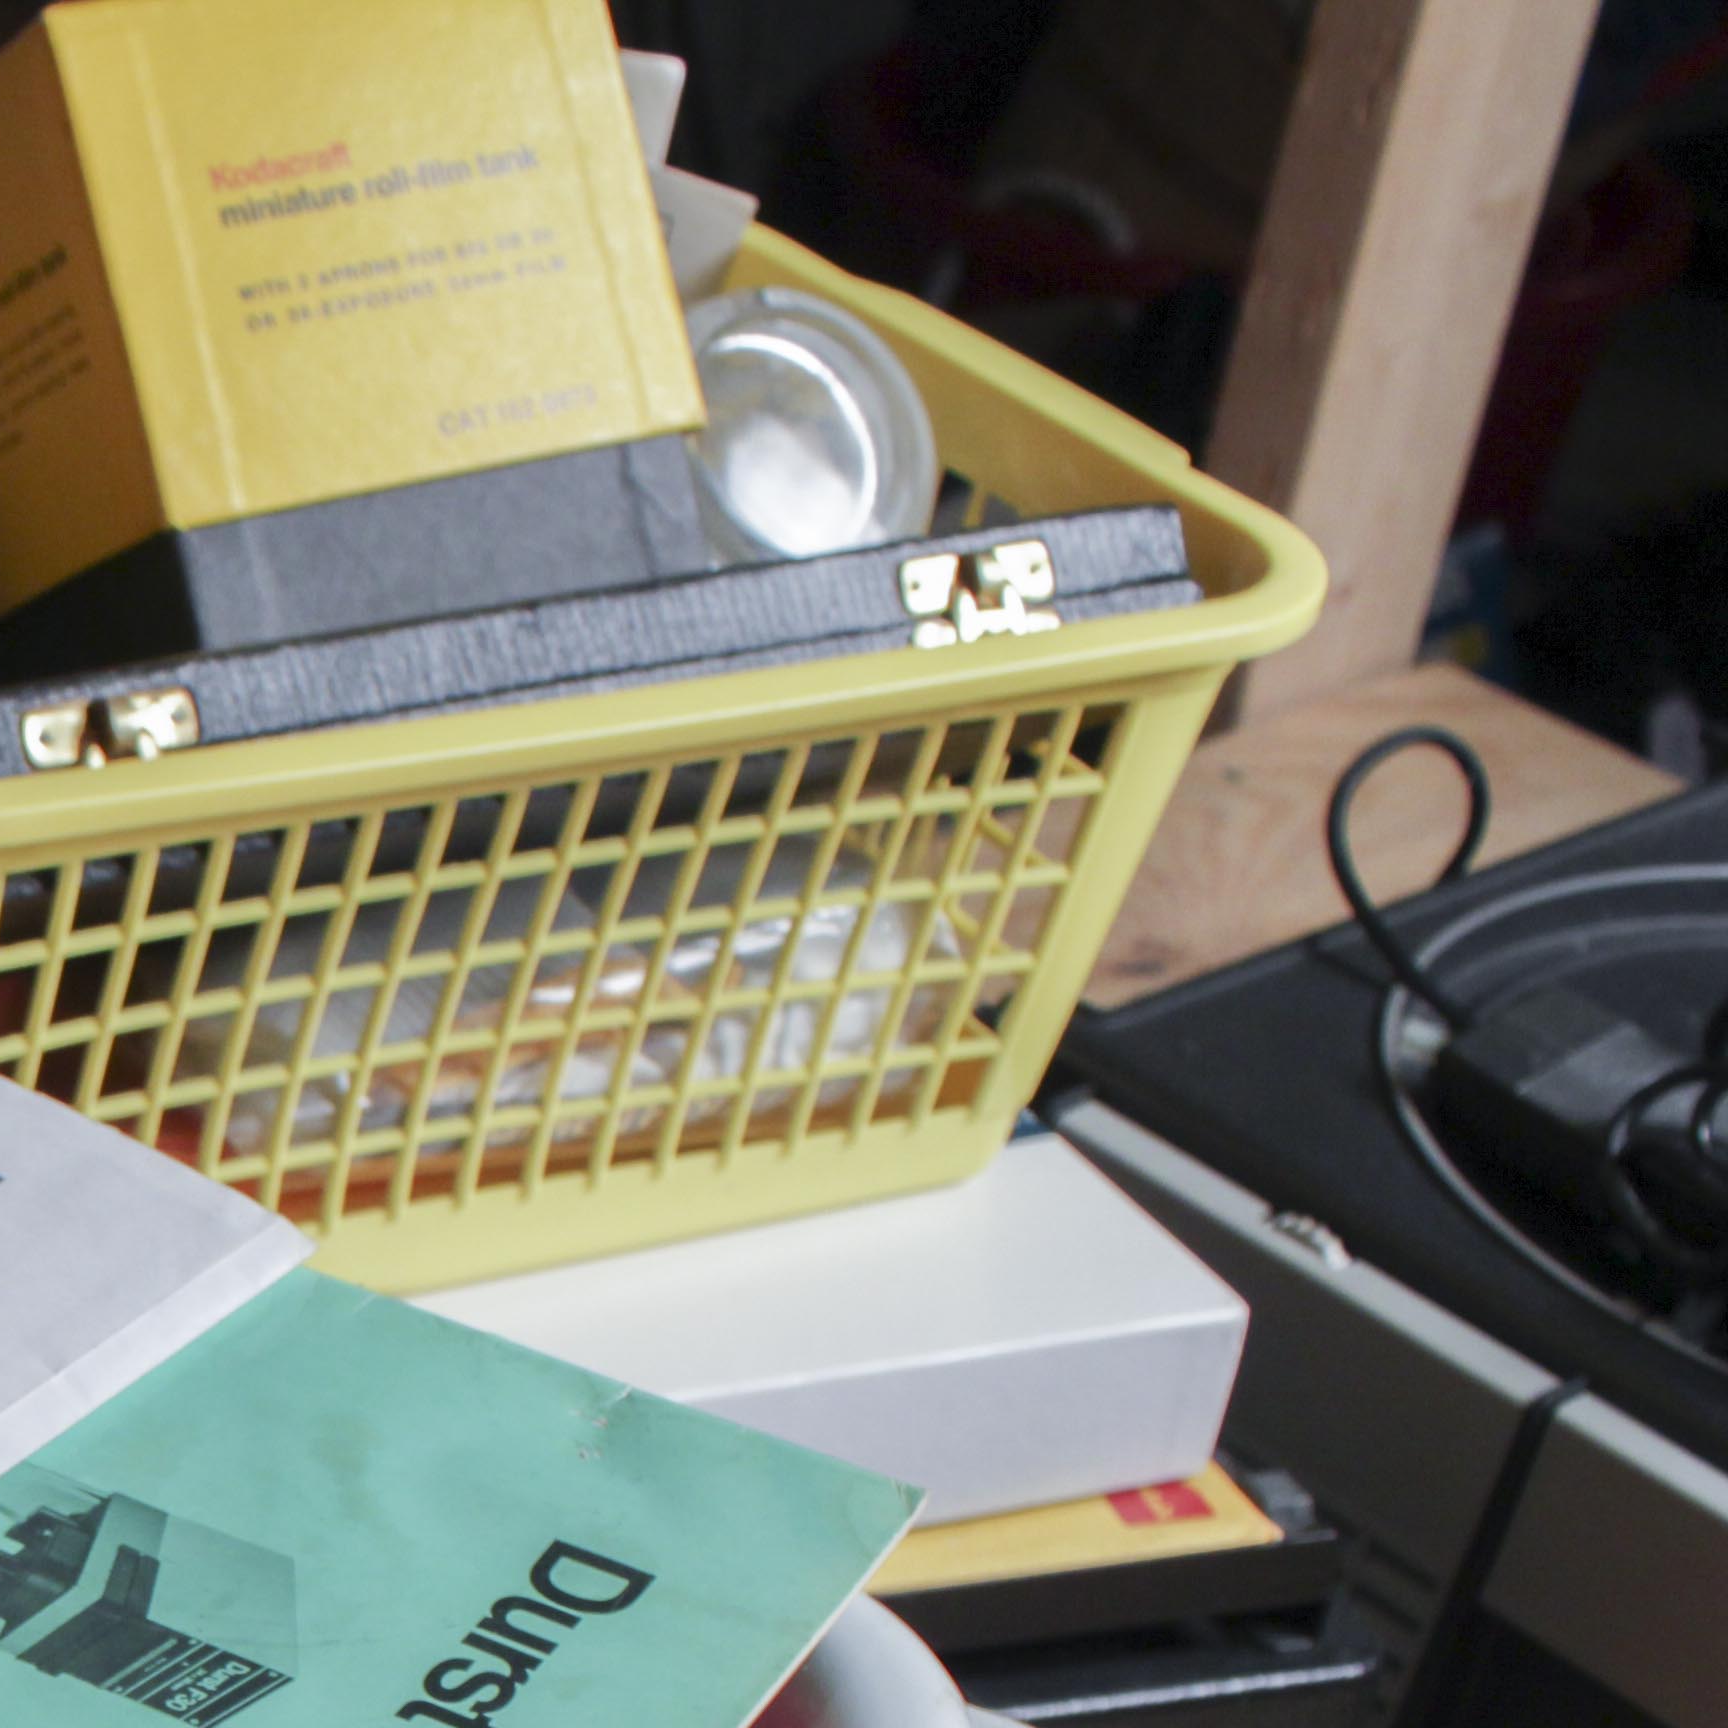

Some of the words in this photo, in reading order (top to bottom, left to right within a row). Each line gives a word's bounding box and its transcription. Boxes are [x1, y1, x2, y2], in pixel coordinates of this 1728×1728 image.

[218, 179, 356, 228] miniature
[364, 161, 472, 201] roll-film
[475, 144, 539, 181] tank
